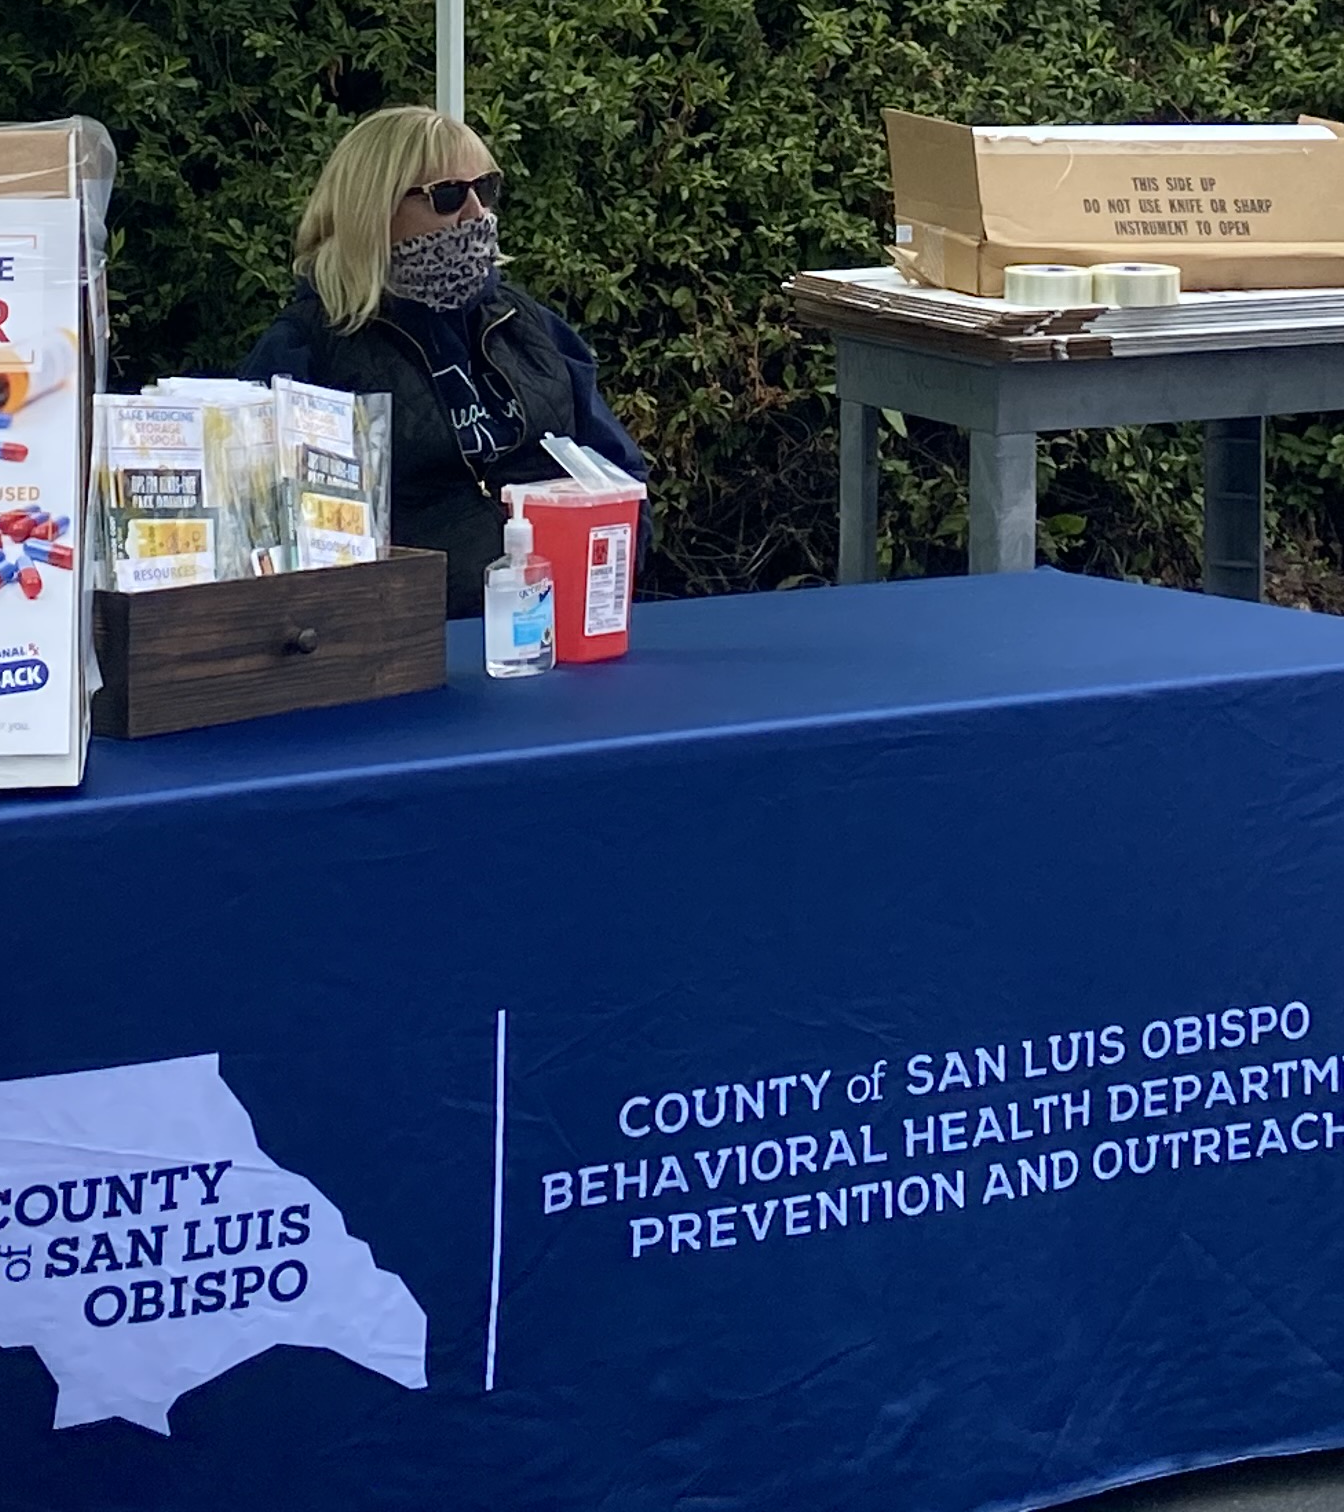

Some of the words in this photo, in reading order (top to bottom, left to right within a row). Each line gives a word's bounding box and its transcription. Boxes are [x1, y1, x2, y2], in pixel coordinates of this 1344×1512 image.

[1083, 199, 1100, 213] DO
[1107, 199, 1131, 213] NOT
[1139, 199, 1162, 213] USE
[1168, 199, 1204, 214] KNIFE
[1210, 199, 1227, 214] OR
[1233, 199, 1273, 214] SHARP
[1131, 177, 1159, 192] THIS
[1165, 177, 1194, 192] SIDE
[1200, 177, 1216, 192] UP
[1115, 220, 1188, 236] INSTRUMENT
[1195, 221, 1211, 236] TO
[1219, 221, 1251, 236] OPEN
[133, 565, 197, 581] RESOURCES
[619, 1070, 832, 1139] COUNTY
[846, 1059, 888, 1104] of
[906, 1044, 1006, 1095] SAN
[1022, 1025, 1126, 1079] LUIS
[1142, 1000, 1310, 1060] OBISPO
[542, 1125, 887, 1215] BEHAVIORAL
[903, 1089, 1090, 1158] HEALTH
[629, 1170, 966, 1258] PREVENTION
[982, 1149, 1079, 1205] AND
[44, 1225, 169, 1278] SAN
[182, 1204, 311, 1261] LUIS
[84, 1259, 308, 1327] OBISPO
